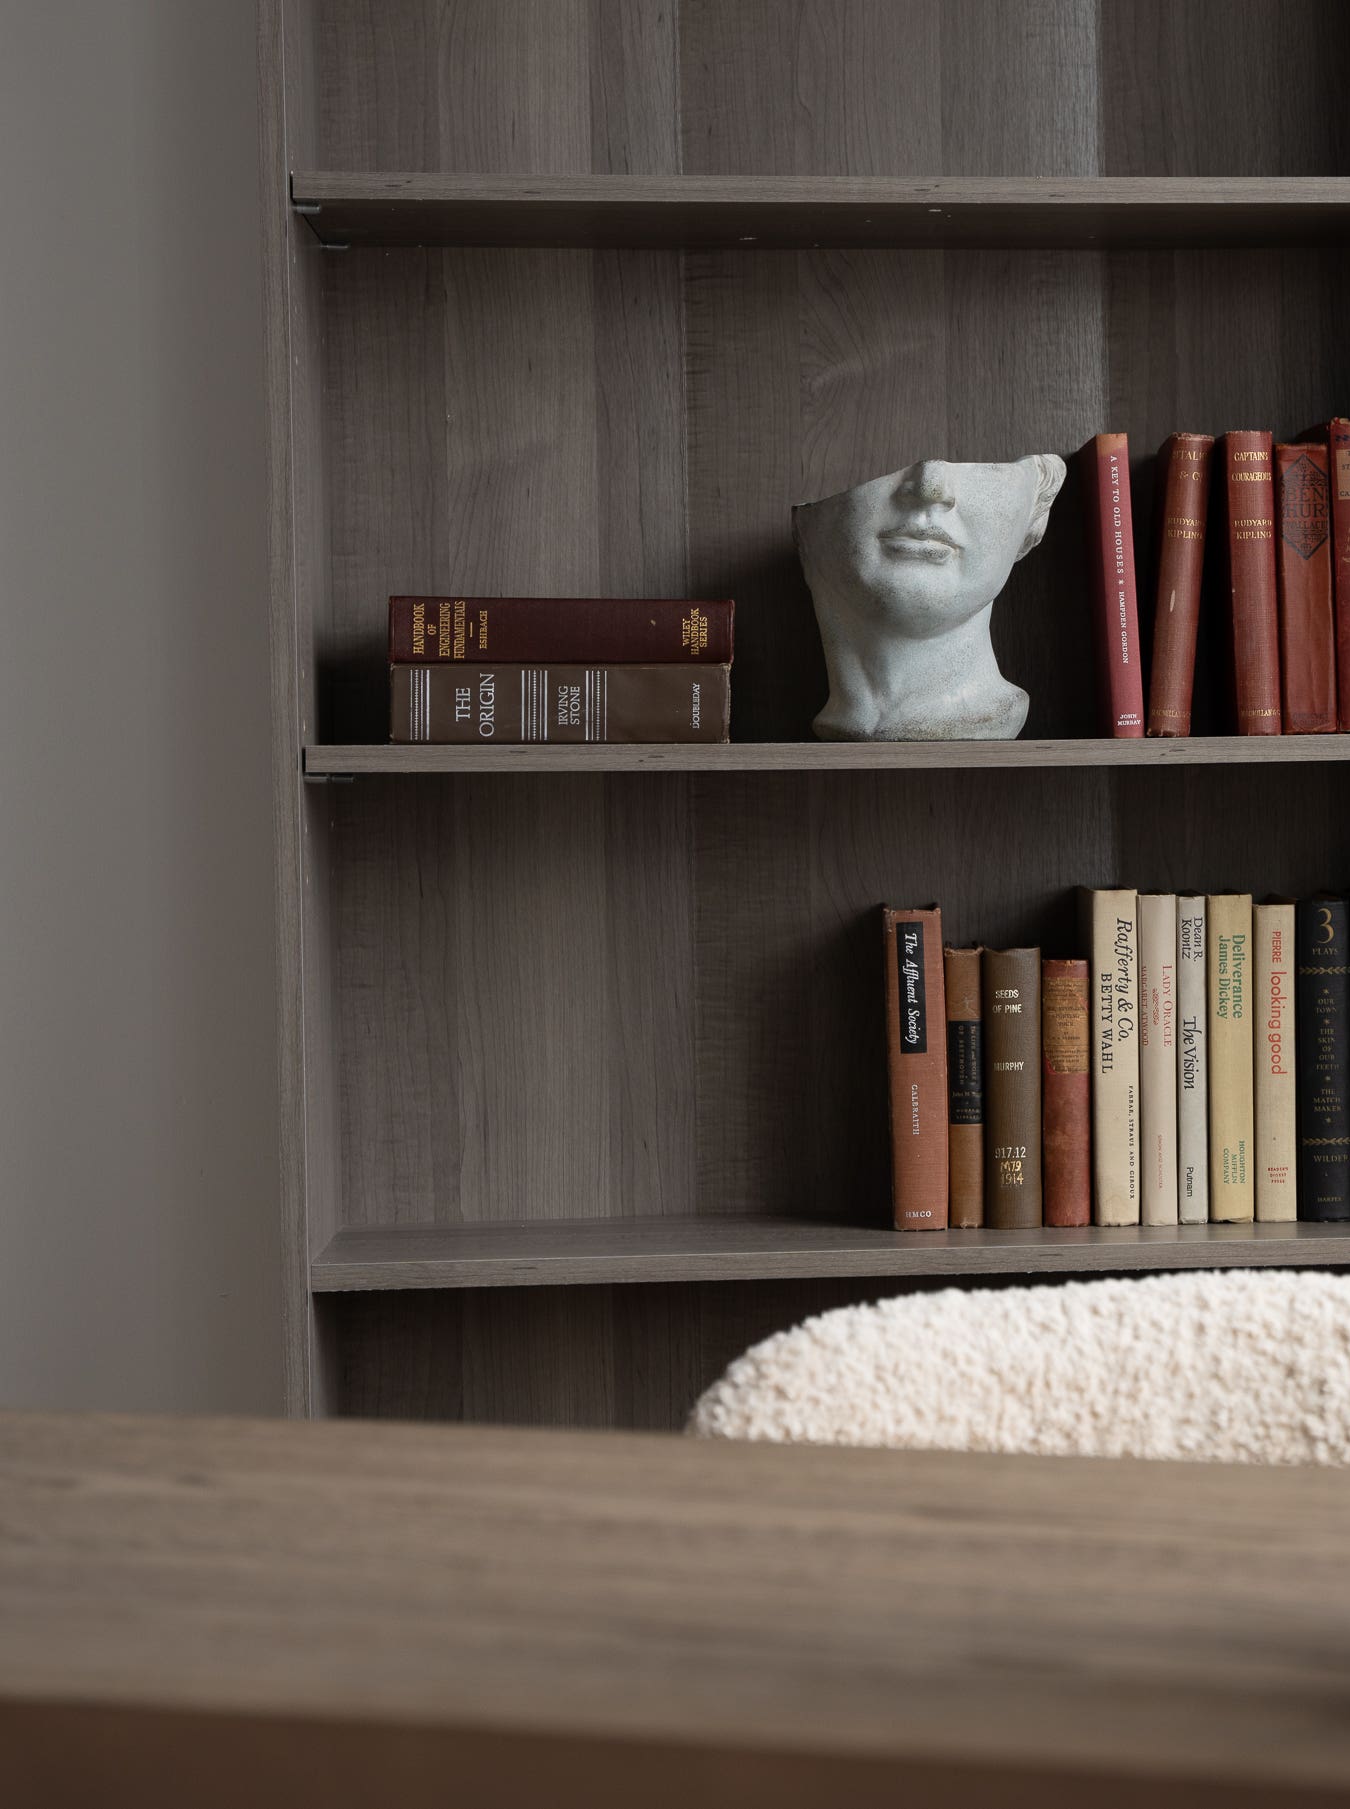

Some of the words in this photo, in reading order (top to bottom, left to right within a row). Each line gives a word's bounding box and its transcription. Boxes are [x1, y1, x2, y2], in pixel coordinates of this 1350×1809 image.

[1110, 455, 1118, 463] A
[1234, 451, 1268, 462] CAPTAINS
[1110, 466, 1119, 485] KEY
[1231, 472, 1272, 482] COURAGEOUS
[1112, 488, 1120, 503] TO
[1286, 486, 1325, 502] BEN
[1112, 506, 1121, 527] OLD
[1234, 519, 1272, 528] RUDYARD
[1286, 503, 1325, 518] HUR
[1236, 530, 1272, 540] KIPLING
[1114, 531, 1124, 574] HOUSES
[1119, 591, 1127, 629] HAMPDEN
[412, 602, 425, 654] HANDBOOK
[427, 623, 437, 636] OF
[438, 602, 451, 657] ENGINEERING
[453, 600, 466, 659] FUNDAMENTALS
[480, 610, 488, 649] ESHBACH
[682, 618, 691, 647] WILEY
[690, 607, 700, 655] HANDBOOK
[700, 616, 708, 648] SERIES
[1120, 630, 1129, 664] GORDON
[455, 687, 471, 722] THE
[478, 672, 495, 737] ORIGIN
[558, 685, 569, 725] IRVING
[569, 686, 580, 725] STONE
[692, 682, 700, 728] DOUBLEDAY
[1117, 719, 1142, 727] MURRAY
[1181, 919, 1192, 960] Koontz
[1193, 916, 1203, 948] Dean
[1316, 907, 1335, 944] 3
[904, 932, 918, 955] The
[1114, 917, 1134, 994] Rafferty
[1193, 950, 1203, 962] R.
[1218, 935, 1231, 975] James
[1271, 931, 1282, 964] PIERRE
[1312, 947, 1338, 956] PLAYS
[902, 958, 920, 1004] Affluent
[1162, 965, 1173, 996] LADY
[1232, 934, 1246, 1019] Deliverance
[992, 1004, 1002, 1014] OF
[1004, 1003, 1022, 1014] PINE
[995, 989, 1019, 999] SEEDS
[1101, 973, 1113, 1022] BETTY
[1117, 997, 1134, 1012] &
[1216, 978, 1231, 1020] Dickey
[1268, 971, 1288, 1029] looking
[904, 1008, 921, 1045] Society
[1117, 1017, 1134, 1042] Co.
[1141, 1011, 1149, 1046] ATWOOD
[1162, 1000, 1174, 1047] ORACLE
[1183, 1016, 1202, 1045] The
[993, 1061, 1024, 1071] MURPHY
[1101, 1028, 1113, 1074] WAHL
[1268, 1033, 1288, 1075] good
[1183, 1046, 1200, 1091] Vision
[911, 1084, 920, 1135] GALBRAITH
[994, 1146, 1027, 1159] 917.12
[1000, 1160, 1022, 1172] M79
[1313, 1154, 1348, 1163] WILDER
[1001, 1172, 1024, 1185] 1914
[1186, 1166, 1194, 1198] Putnam
[905, 1210, 932, 1218] HMCO
